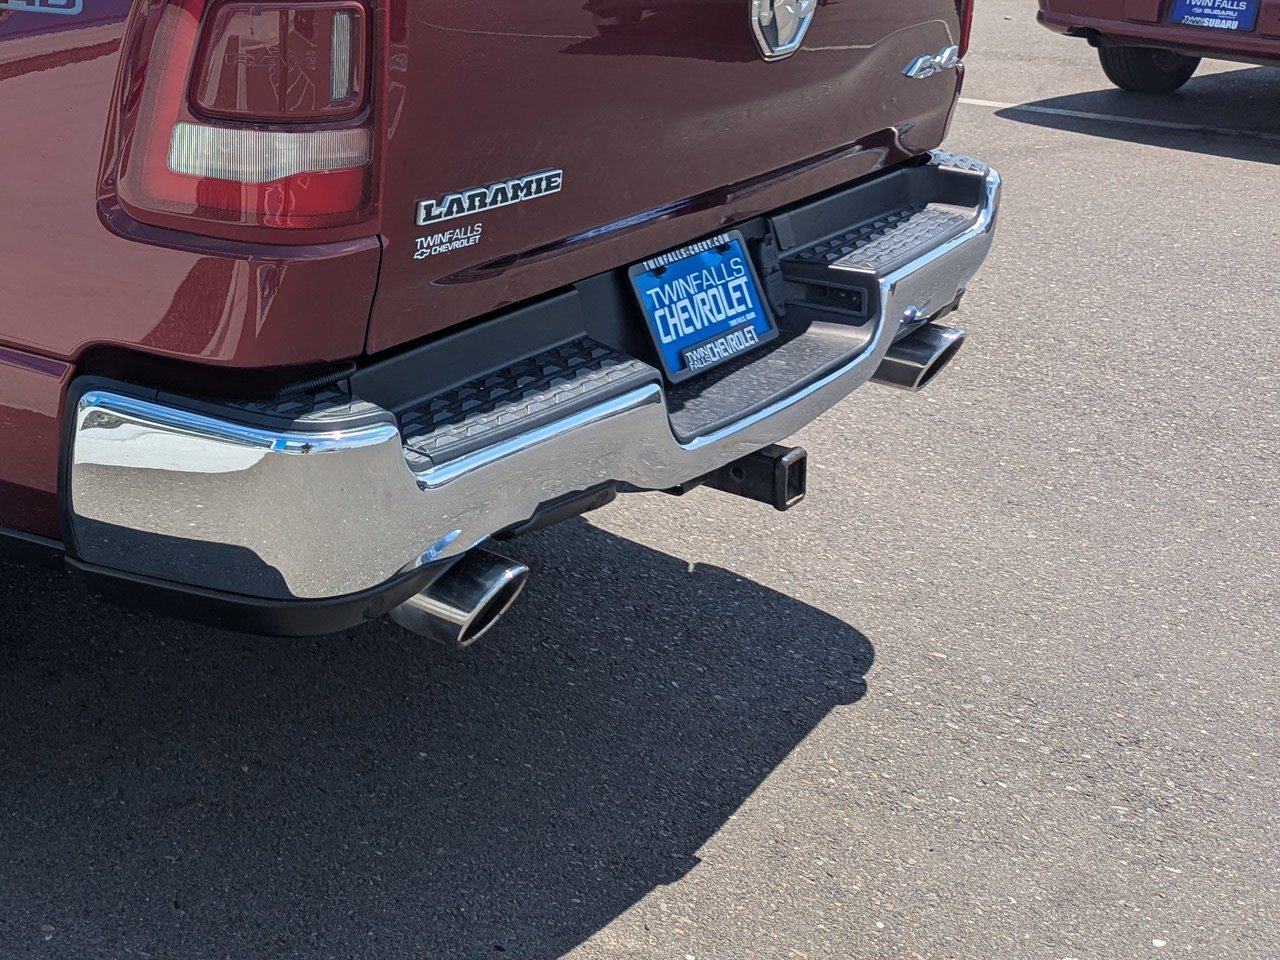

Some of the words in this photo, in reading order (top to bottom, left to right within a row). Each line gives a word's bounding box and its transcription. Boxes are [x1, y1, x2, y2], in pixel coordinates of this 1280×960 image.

[1203, 8, 1238, 17] SUBARU
[1214, 0, 1247, 10] FALLS
[1203, 17, 1239, 30] SUBARU
[416, 168, 563, 226] LARAMIE
[415, 223, 483, 250] TWINFALLS
[431, 235, 481, 255] CHEVROLET
[642, 233, 731, 271] TWINFALLS-CHEVY.COM
[646, 257, 745, 309] TWINFALLS
[654, 277, 754, 344] CHEVROLET
[685, 345, 709, 364] TWIN
[708, 326, 759, 361] CHEVROLET
[688, 356, 713, 371] FALLS
